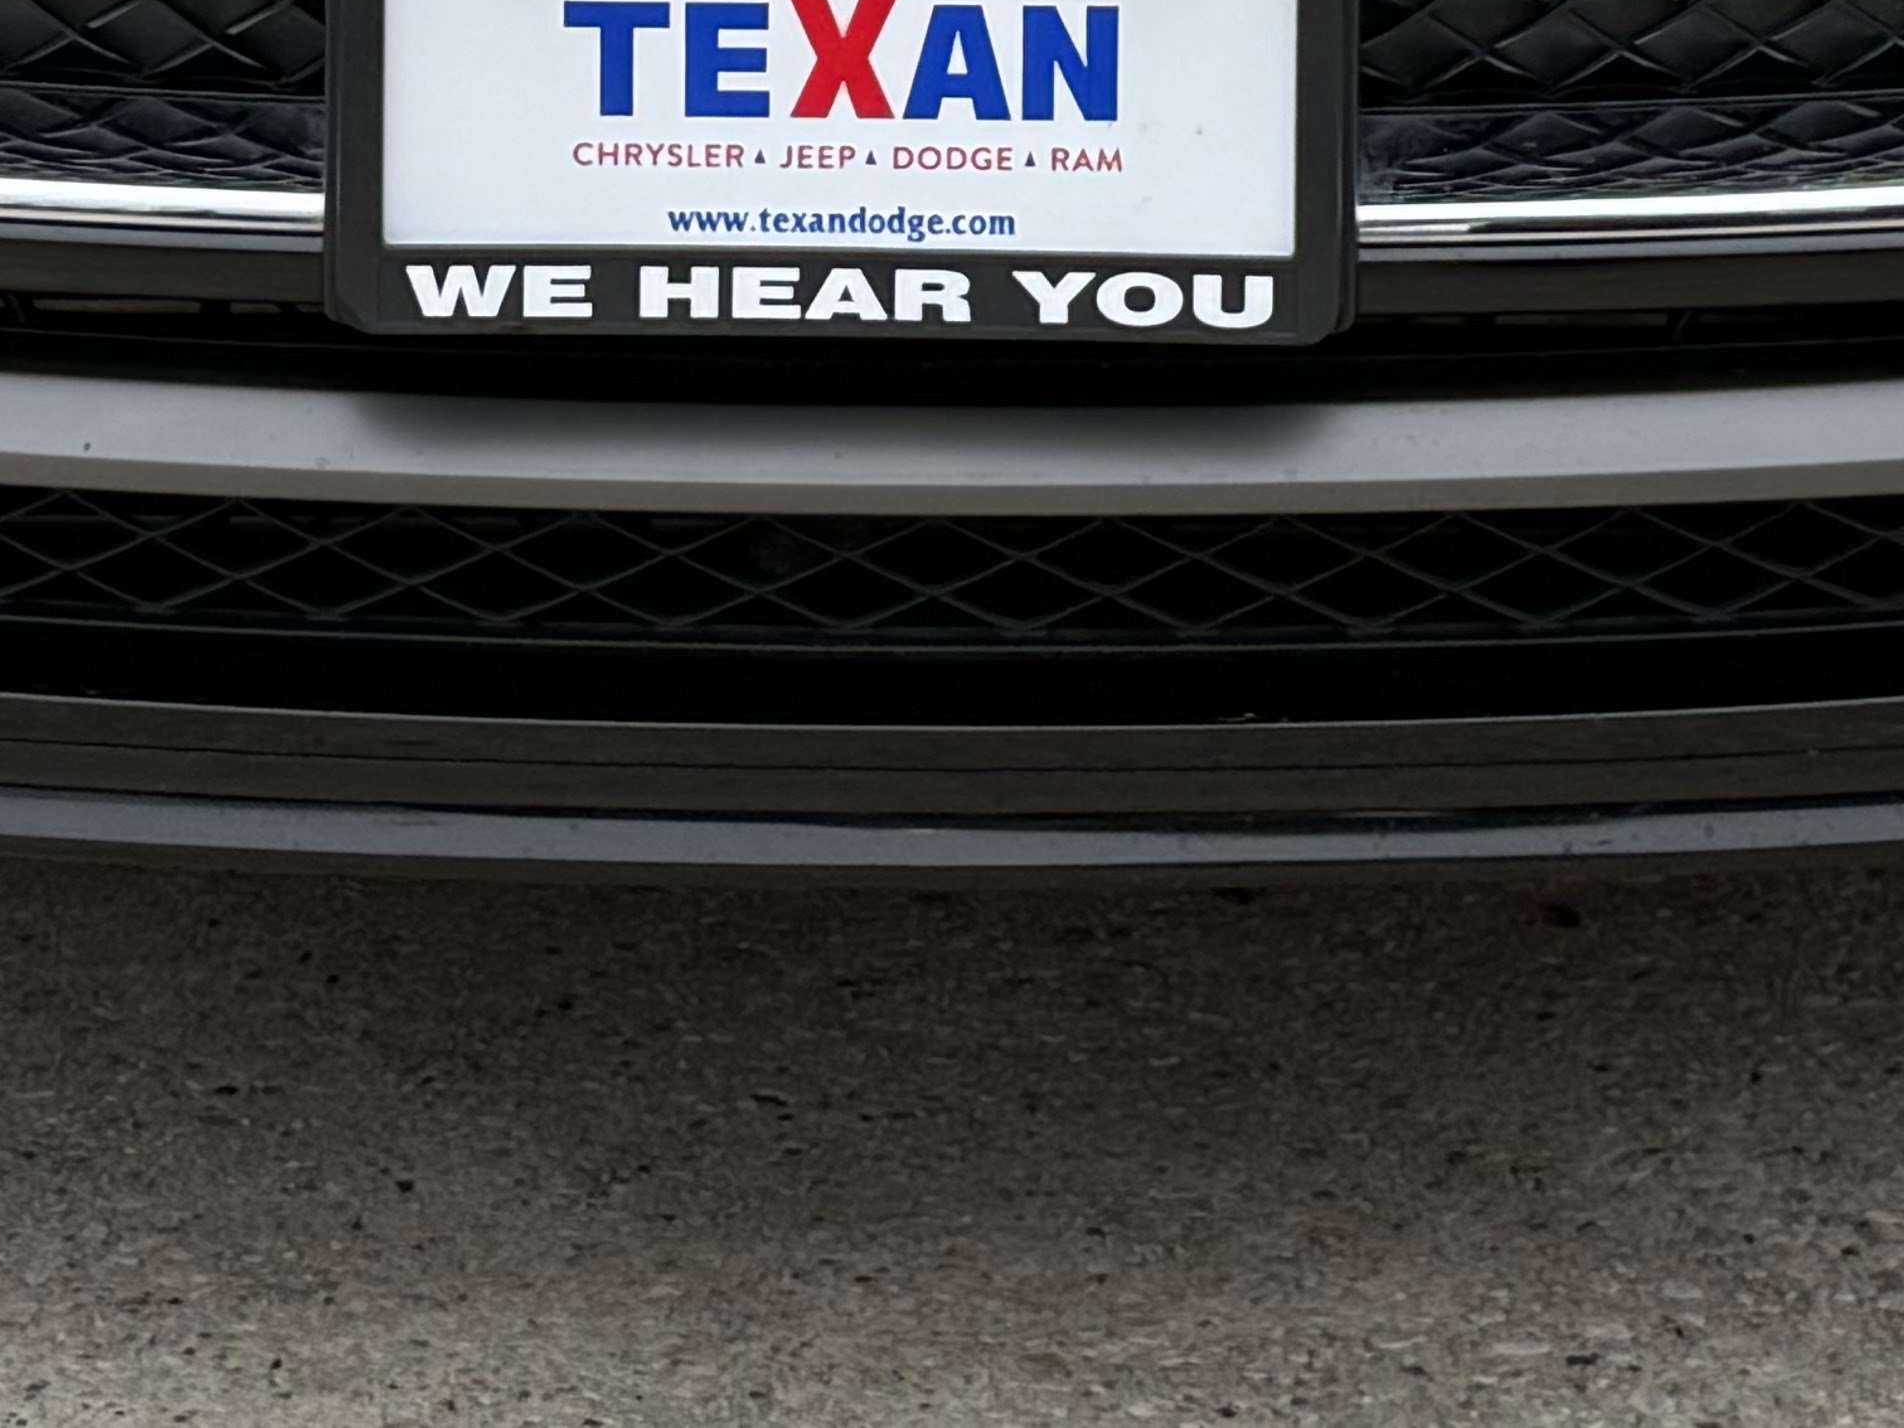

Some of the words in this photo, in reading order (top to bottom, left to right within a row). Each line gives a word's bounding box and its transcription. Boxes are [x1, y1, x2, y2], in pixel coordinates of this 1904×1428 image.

[572, 142, 745, 168] CHRYSLER
[779, 144, 857, 170] JEEP
[892, 146, 1013, 172] DODGE
[1050, 147, 1123, 173] RAM
[667, 206, 1016, 243] www.texandodge.com
[405, 264, 594, 319] WE
[638, 265, 973, 324] HEAR
[1011, 270, 1274, 329] YOU
